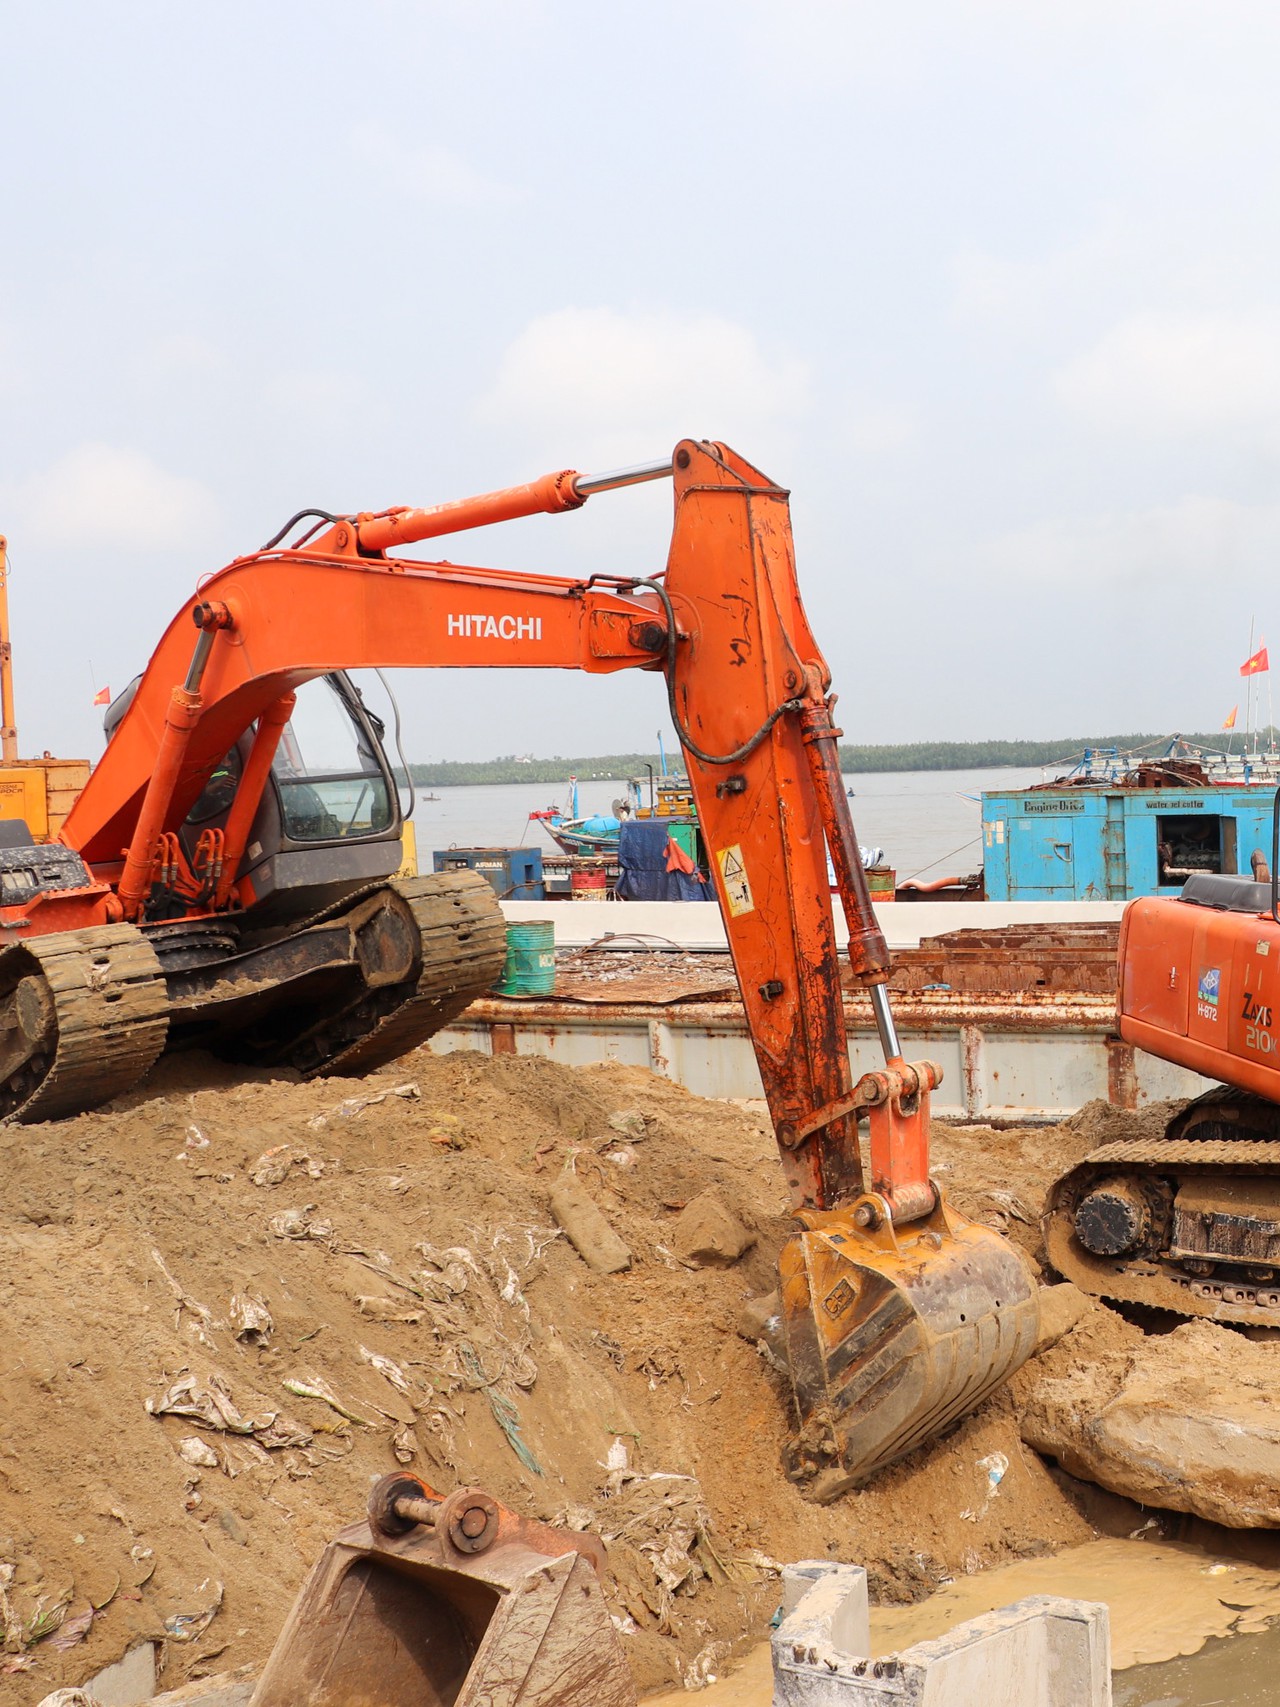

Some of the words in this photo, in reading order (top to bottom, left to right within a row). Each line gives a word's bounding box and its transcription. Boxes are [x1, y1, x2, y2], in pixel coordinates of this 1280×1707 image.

[447, 614, 542, 640] HITACHI
[1024, 801, 1058, 813] Engine
[1197, 1002, 1218, 1022] H-872
